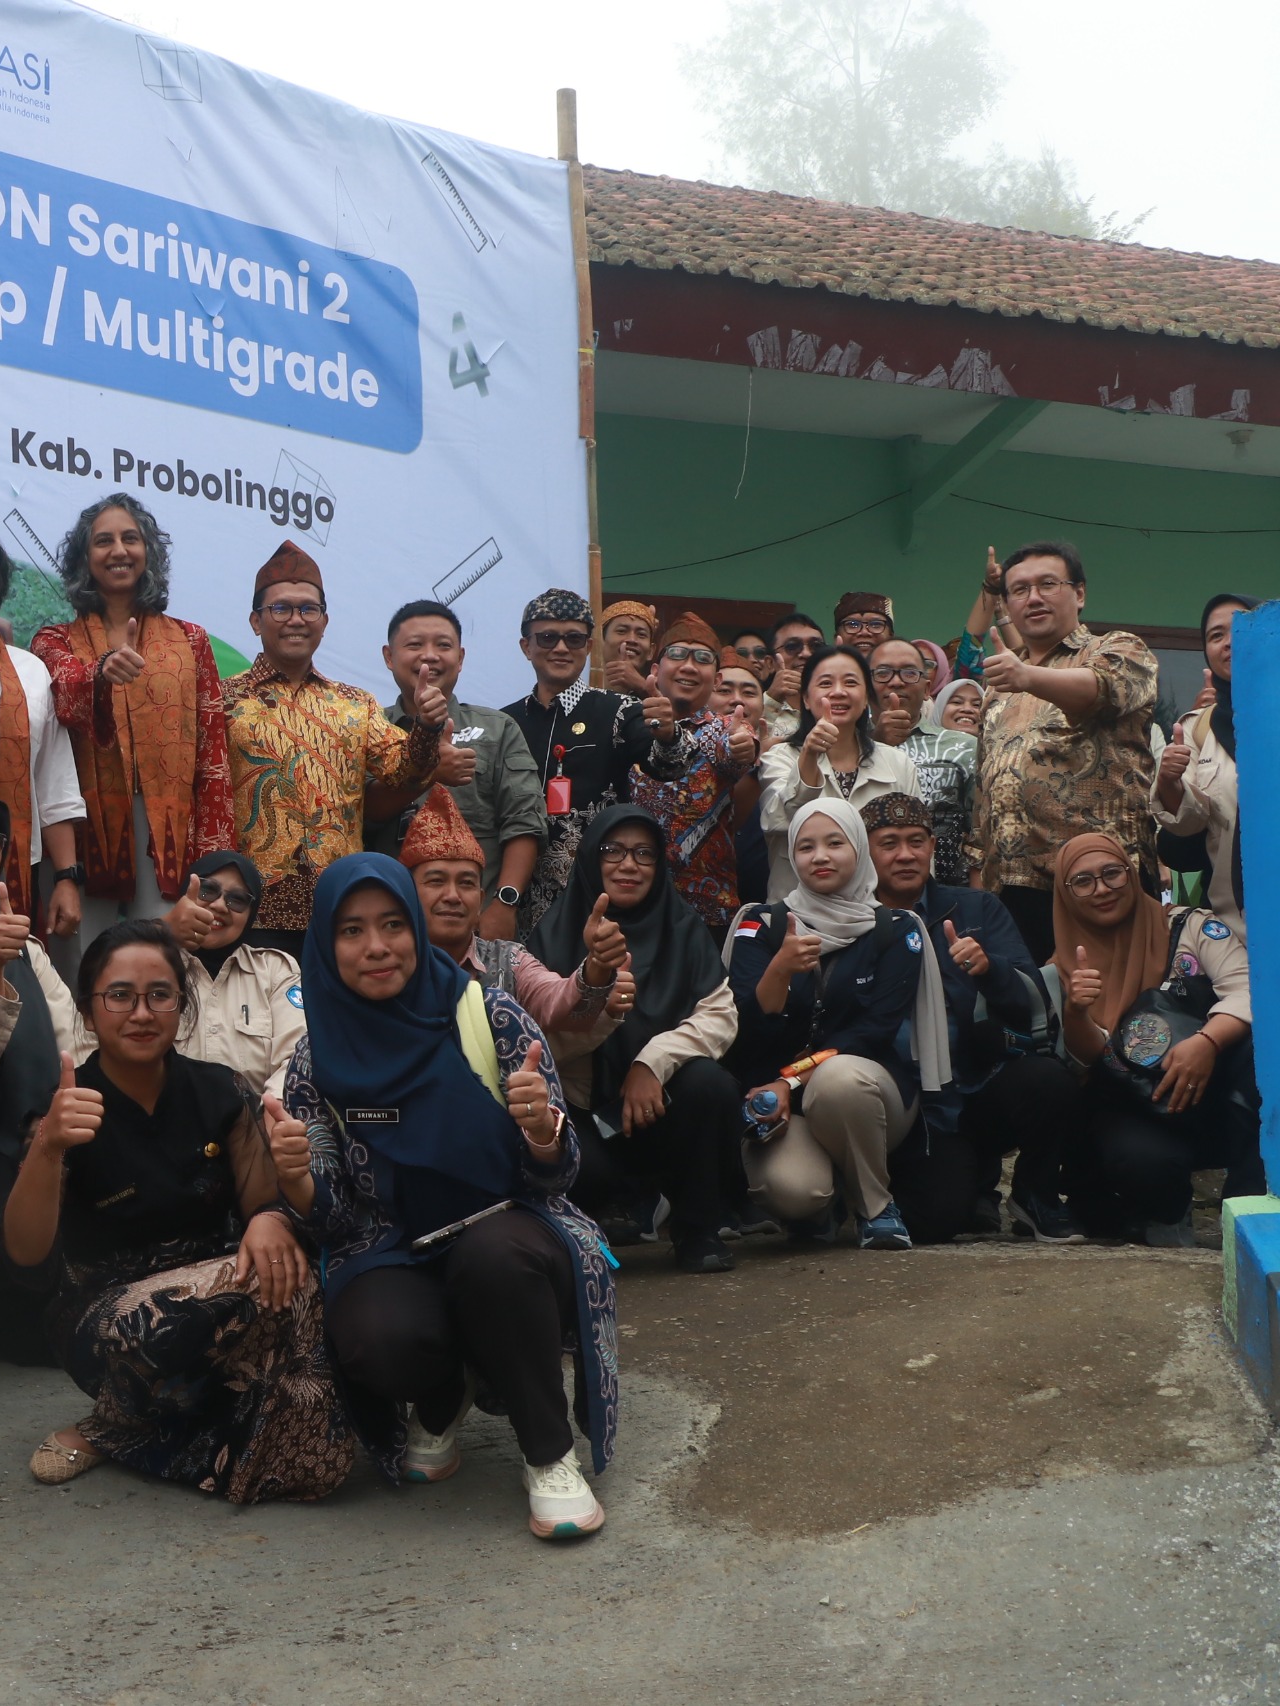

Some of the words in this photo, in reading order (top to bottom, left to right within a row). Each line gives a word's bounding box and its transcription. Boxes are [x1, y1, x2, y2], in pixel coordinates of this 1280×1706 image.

[9, 89, 51, 111] Indonesia
[14, 103, 50, 124] Indonesia
[68, 204, 309, 315] Sariwani
[323, 273, 350, 323] 2
[43, 266, 67, 345] /
[84, 290, 380, 408] Multigrade
[12, 427, 103, 479] Kab.
[113, 448, 334, 530] Probolinggo
